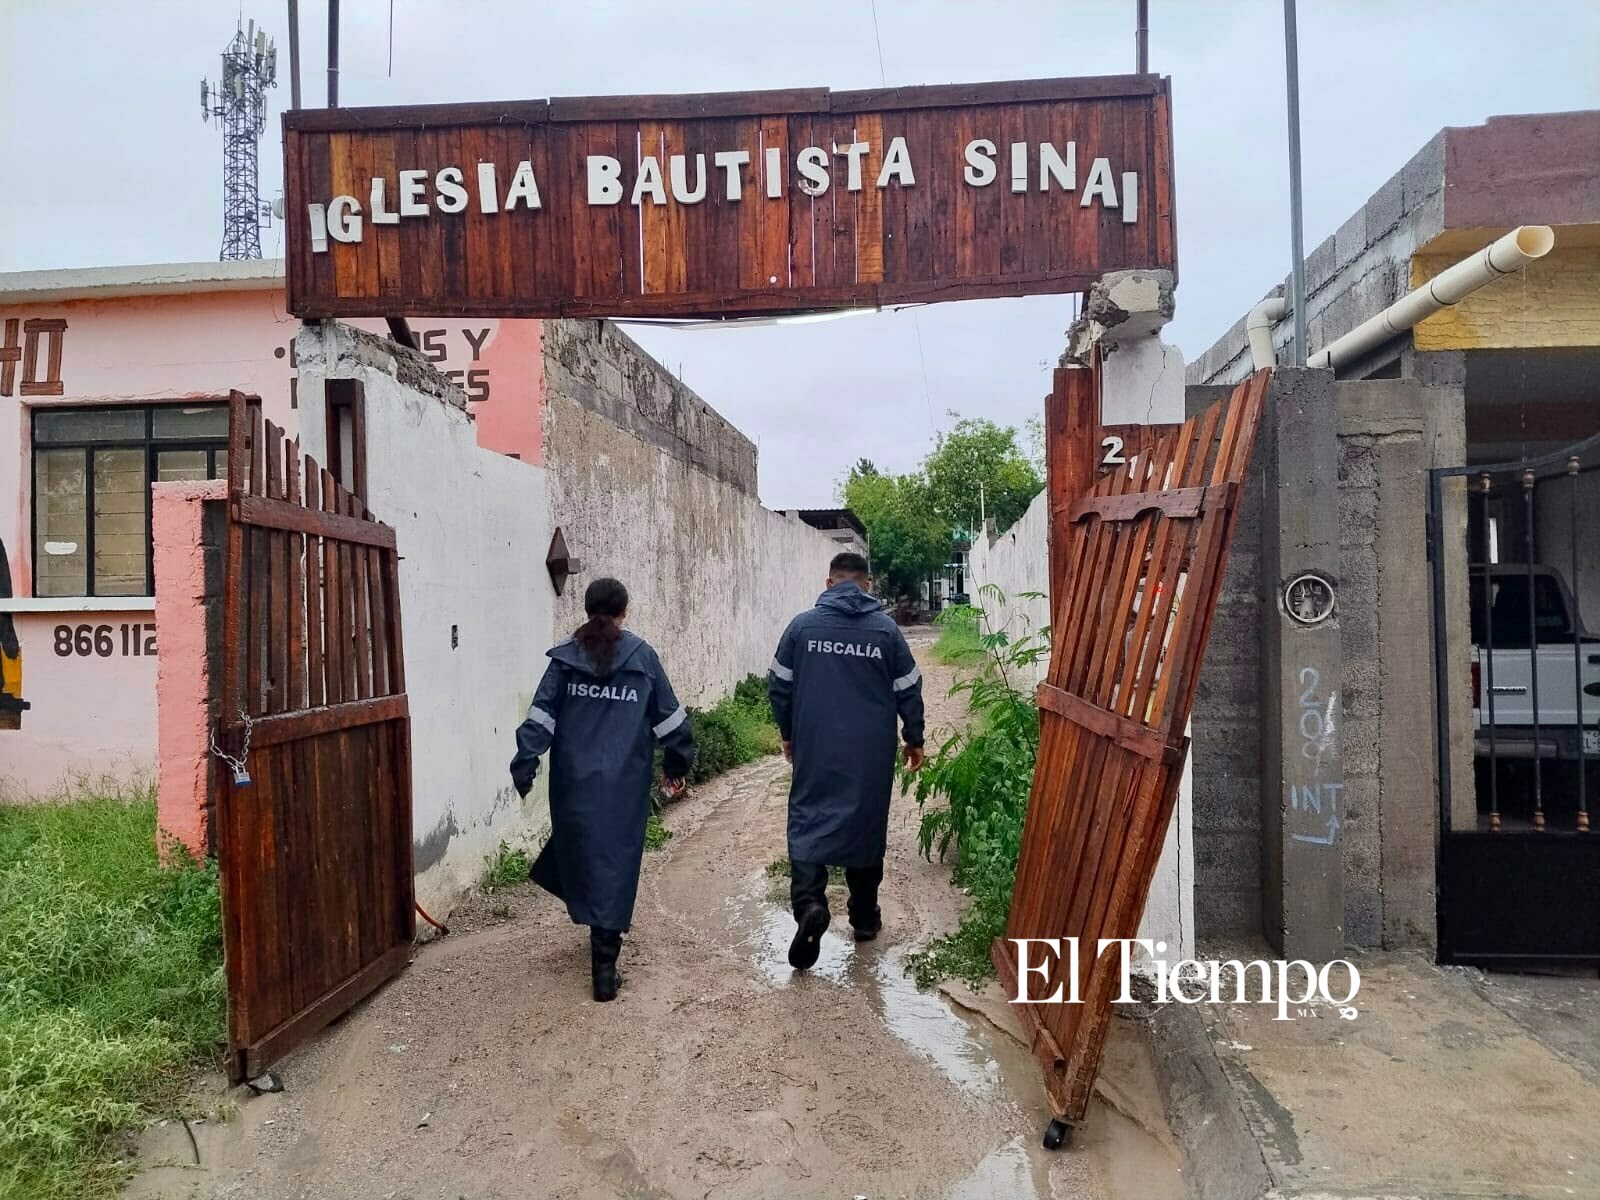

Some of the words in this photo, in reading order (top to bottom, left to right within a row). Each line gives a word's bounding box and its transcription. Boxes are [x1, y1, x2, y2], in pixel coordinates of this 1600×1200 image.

[308, 160, 541, 253] IGLESIA
[587, 137, 915, 205] BAUTISTA
[964, 139, 1137, 224] SINAI
[54, 624, 113, 657] 866
[807, 639, 882, 659] FISCALÍA
[1291, 783, 1344, 814] INT
